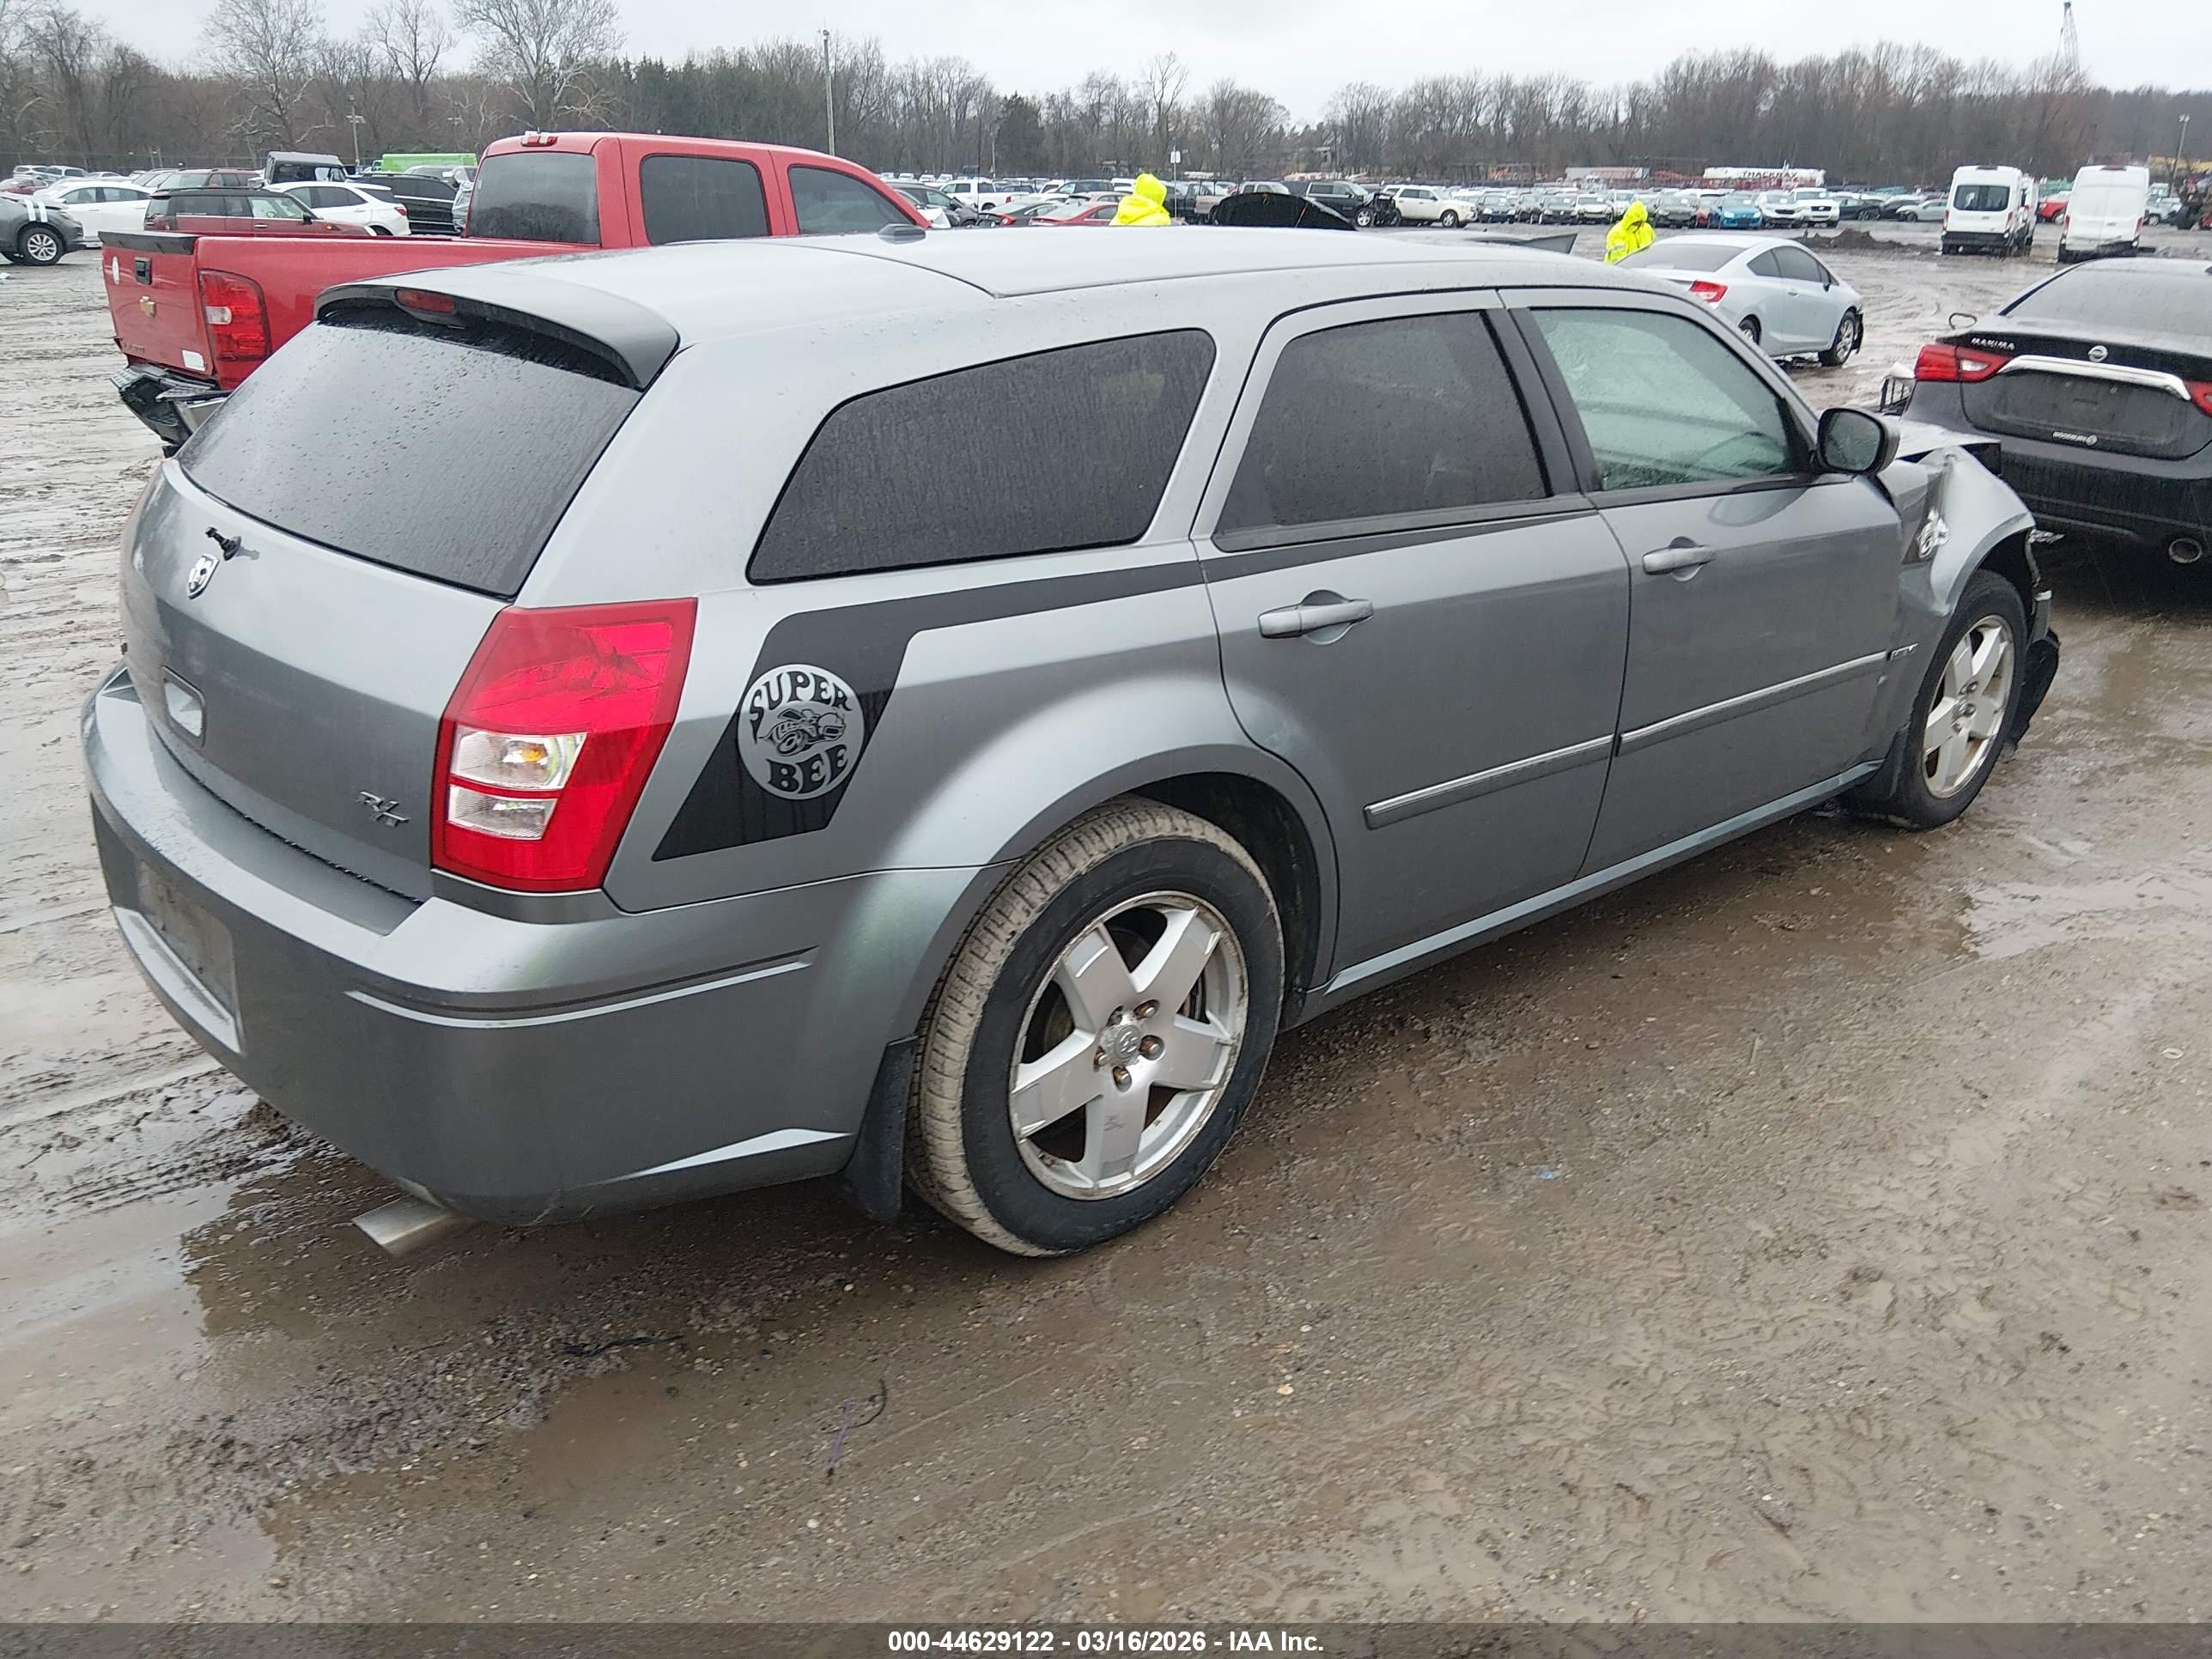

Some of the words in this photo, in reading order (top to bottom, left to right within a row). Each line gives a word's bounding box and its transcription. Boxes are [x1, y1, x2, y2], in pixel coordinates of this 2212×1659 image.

[1971, 337, 2015, 351] MAXIMA
[749, 671, 853, 744] SUPER
[765, 744, 848, 794] BEE
[358, 790, 412, 827] R/T
